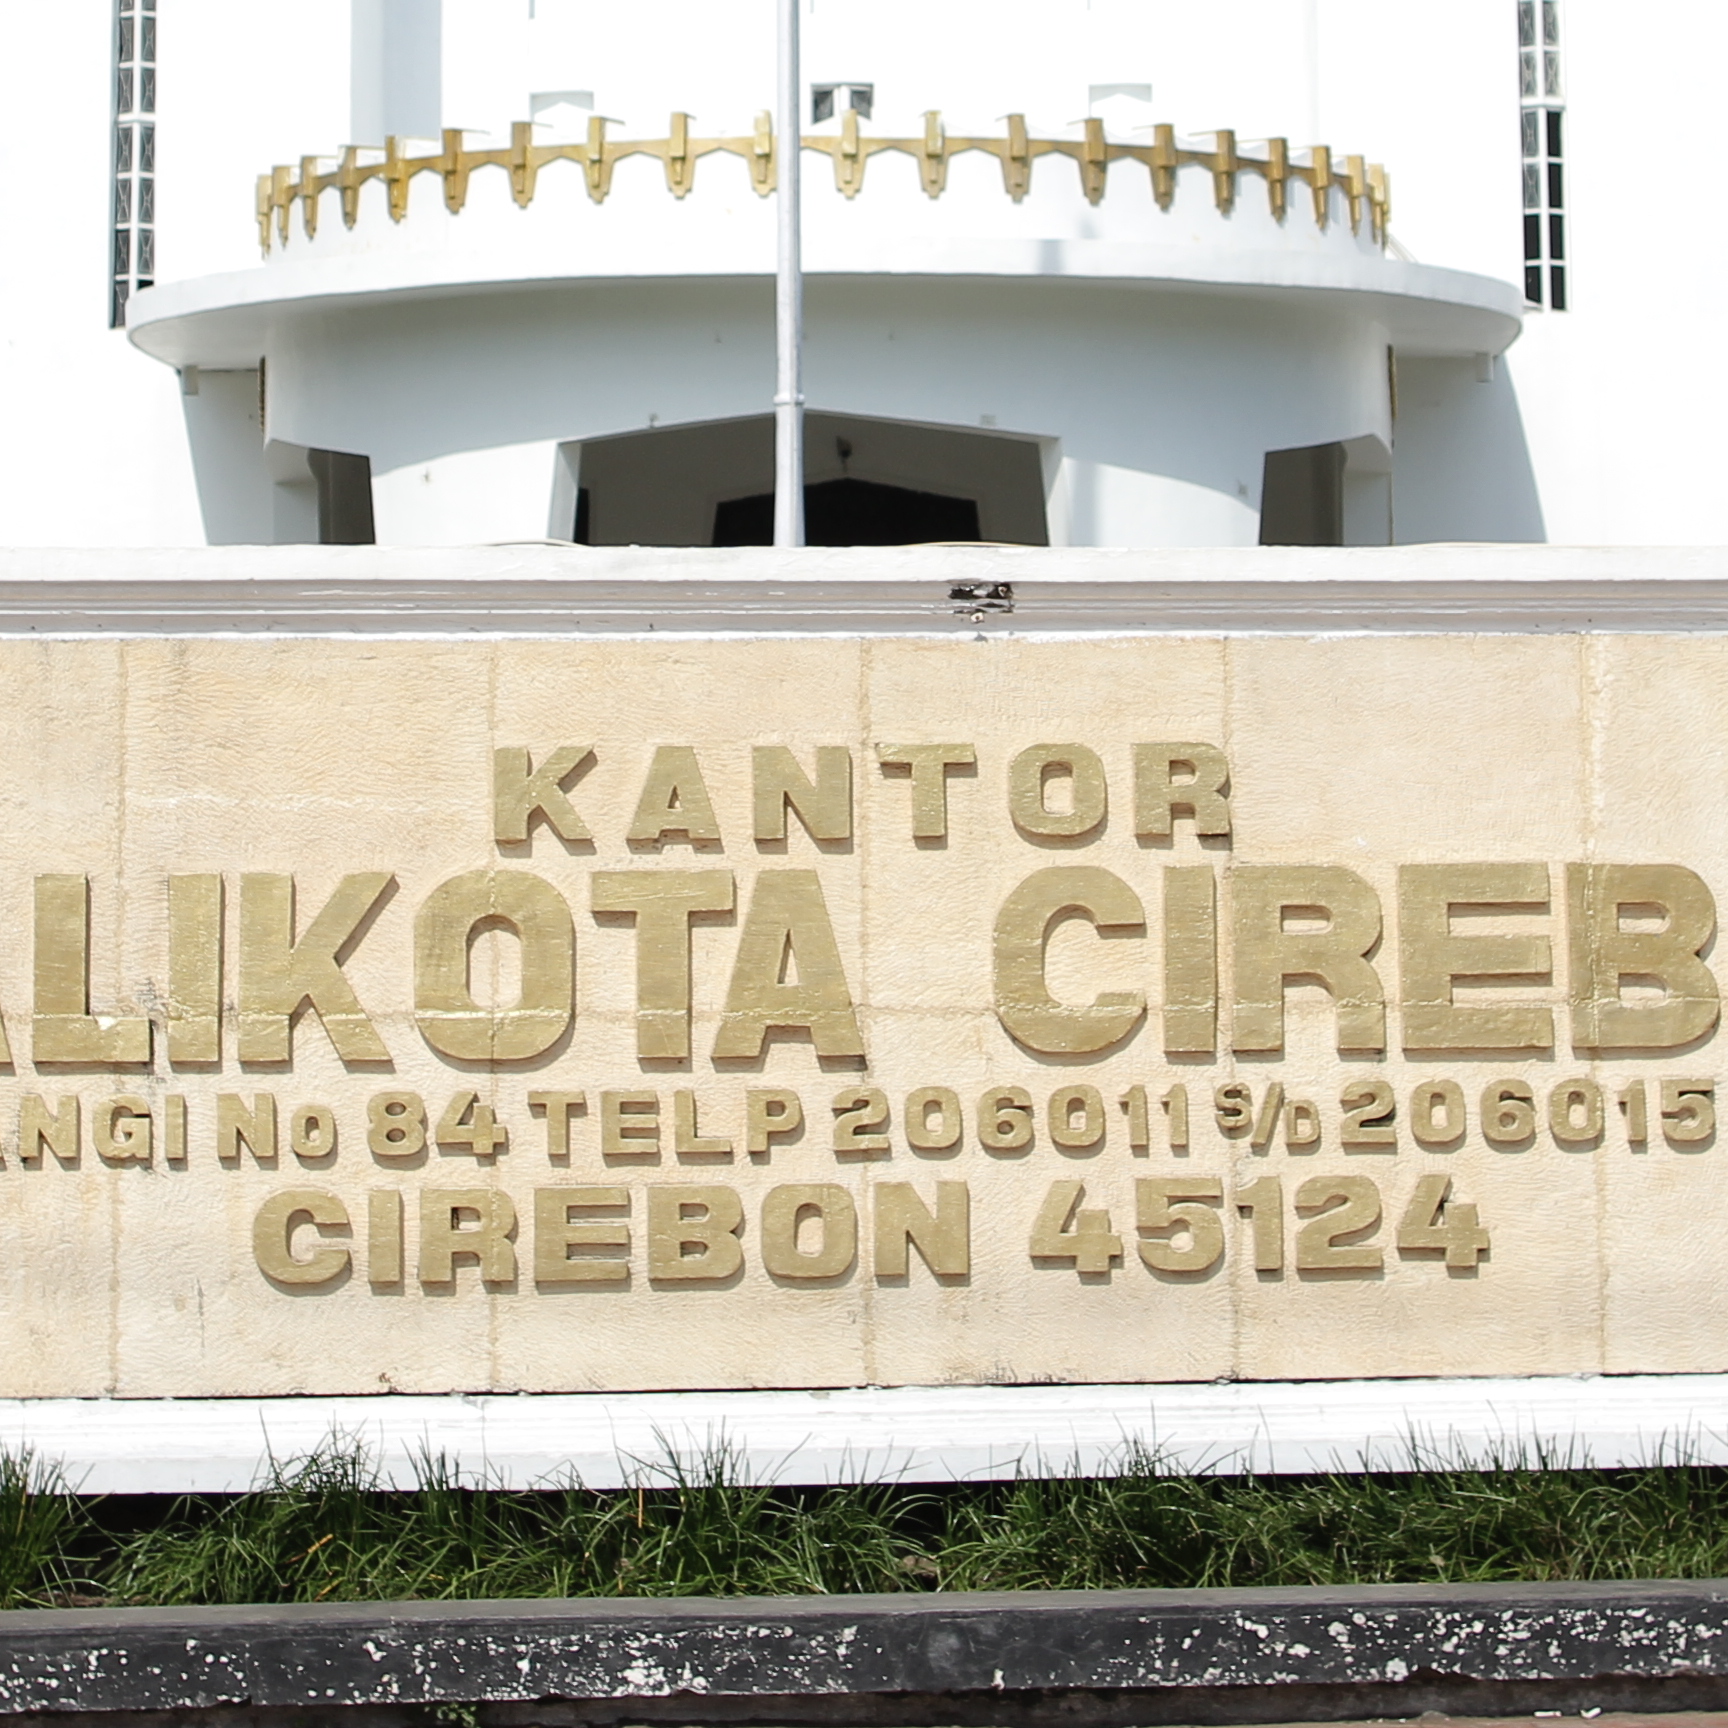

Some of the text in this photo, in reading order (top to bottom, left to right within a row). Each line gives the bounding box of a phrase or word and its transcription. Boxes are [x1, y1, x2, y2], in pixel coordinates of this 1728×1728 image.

[494, 741, 1232, 848] KANTOR
[216, 1092, 337, 1165] No
[366, 1091, 509, 1161] 84
[527, 1089, 805, 1163] TELP
[830, 1084, 1190, 1158] 206011
[1340, 1077, 1717, 1151] 206015
[253, 1173, 1490, 1290] CIREBON 45124
